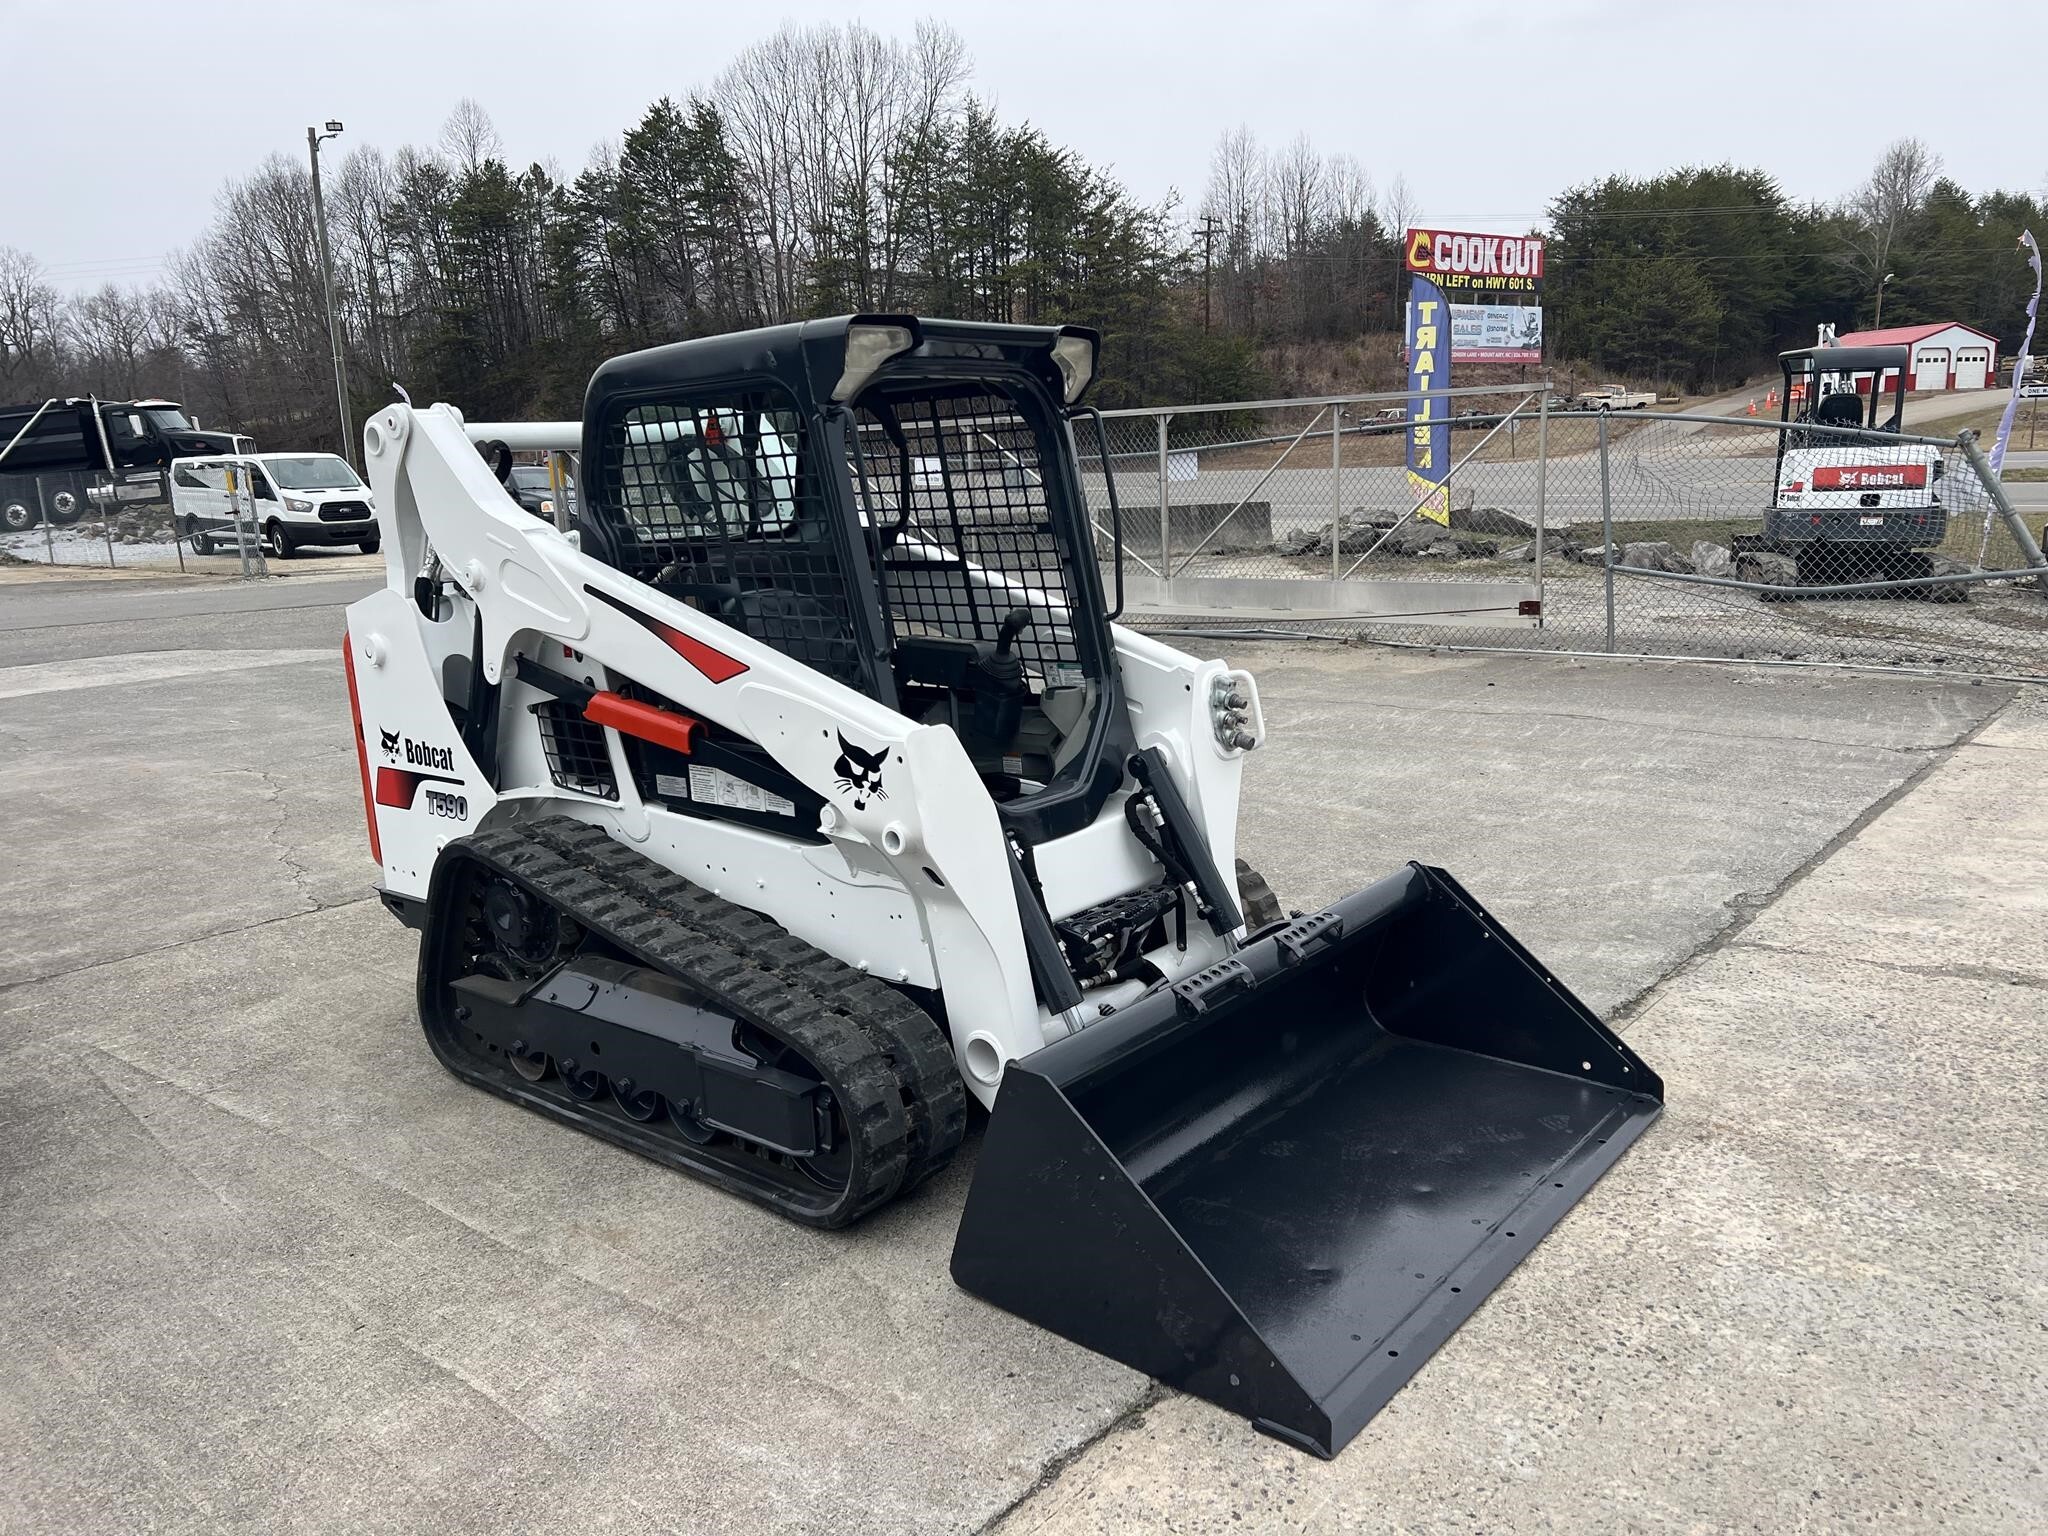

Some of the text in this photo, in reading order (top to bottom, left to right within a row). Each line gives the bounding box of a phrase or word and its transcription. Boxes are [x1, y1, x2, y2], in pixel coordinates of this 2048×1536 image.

[1434, 234, 1542, 276] COOK OUT
[1446, 274, 1470, 287] LEFT
[1472, 279, 1484, 288] on
[1486, 277, 1507, 289] HWY
[1509, 278, 1525, 290] 601
[1526, 278, 1535, 290] S.
[1453, 324, 1482, 335] SALES
[1861, 472, 1904, 486] Bobcat
[404, 738, 455, 772] Bobcat
[425, 789, 468, 822] T590
